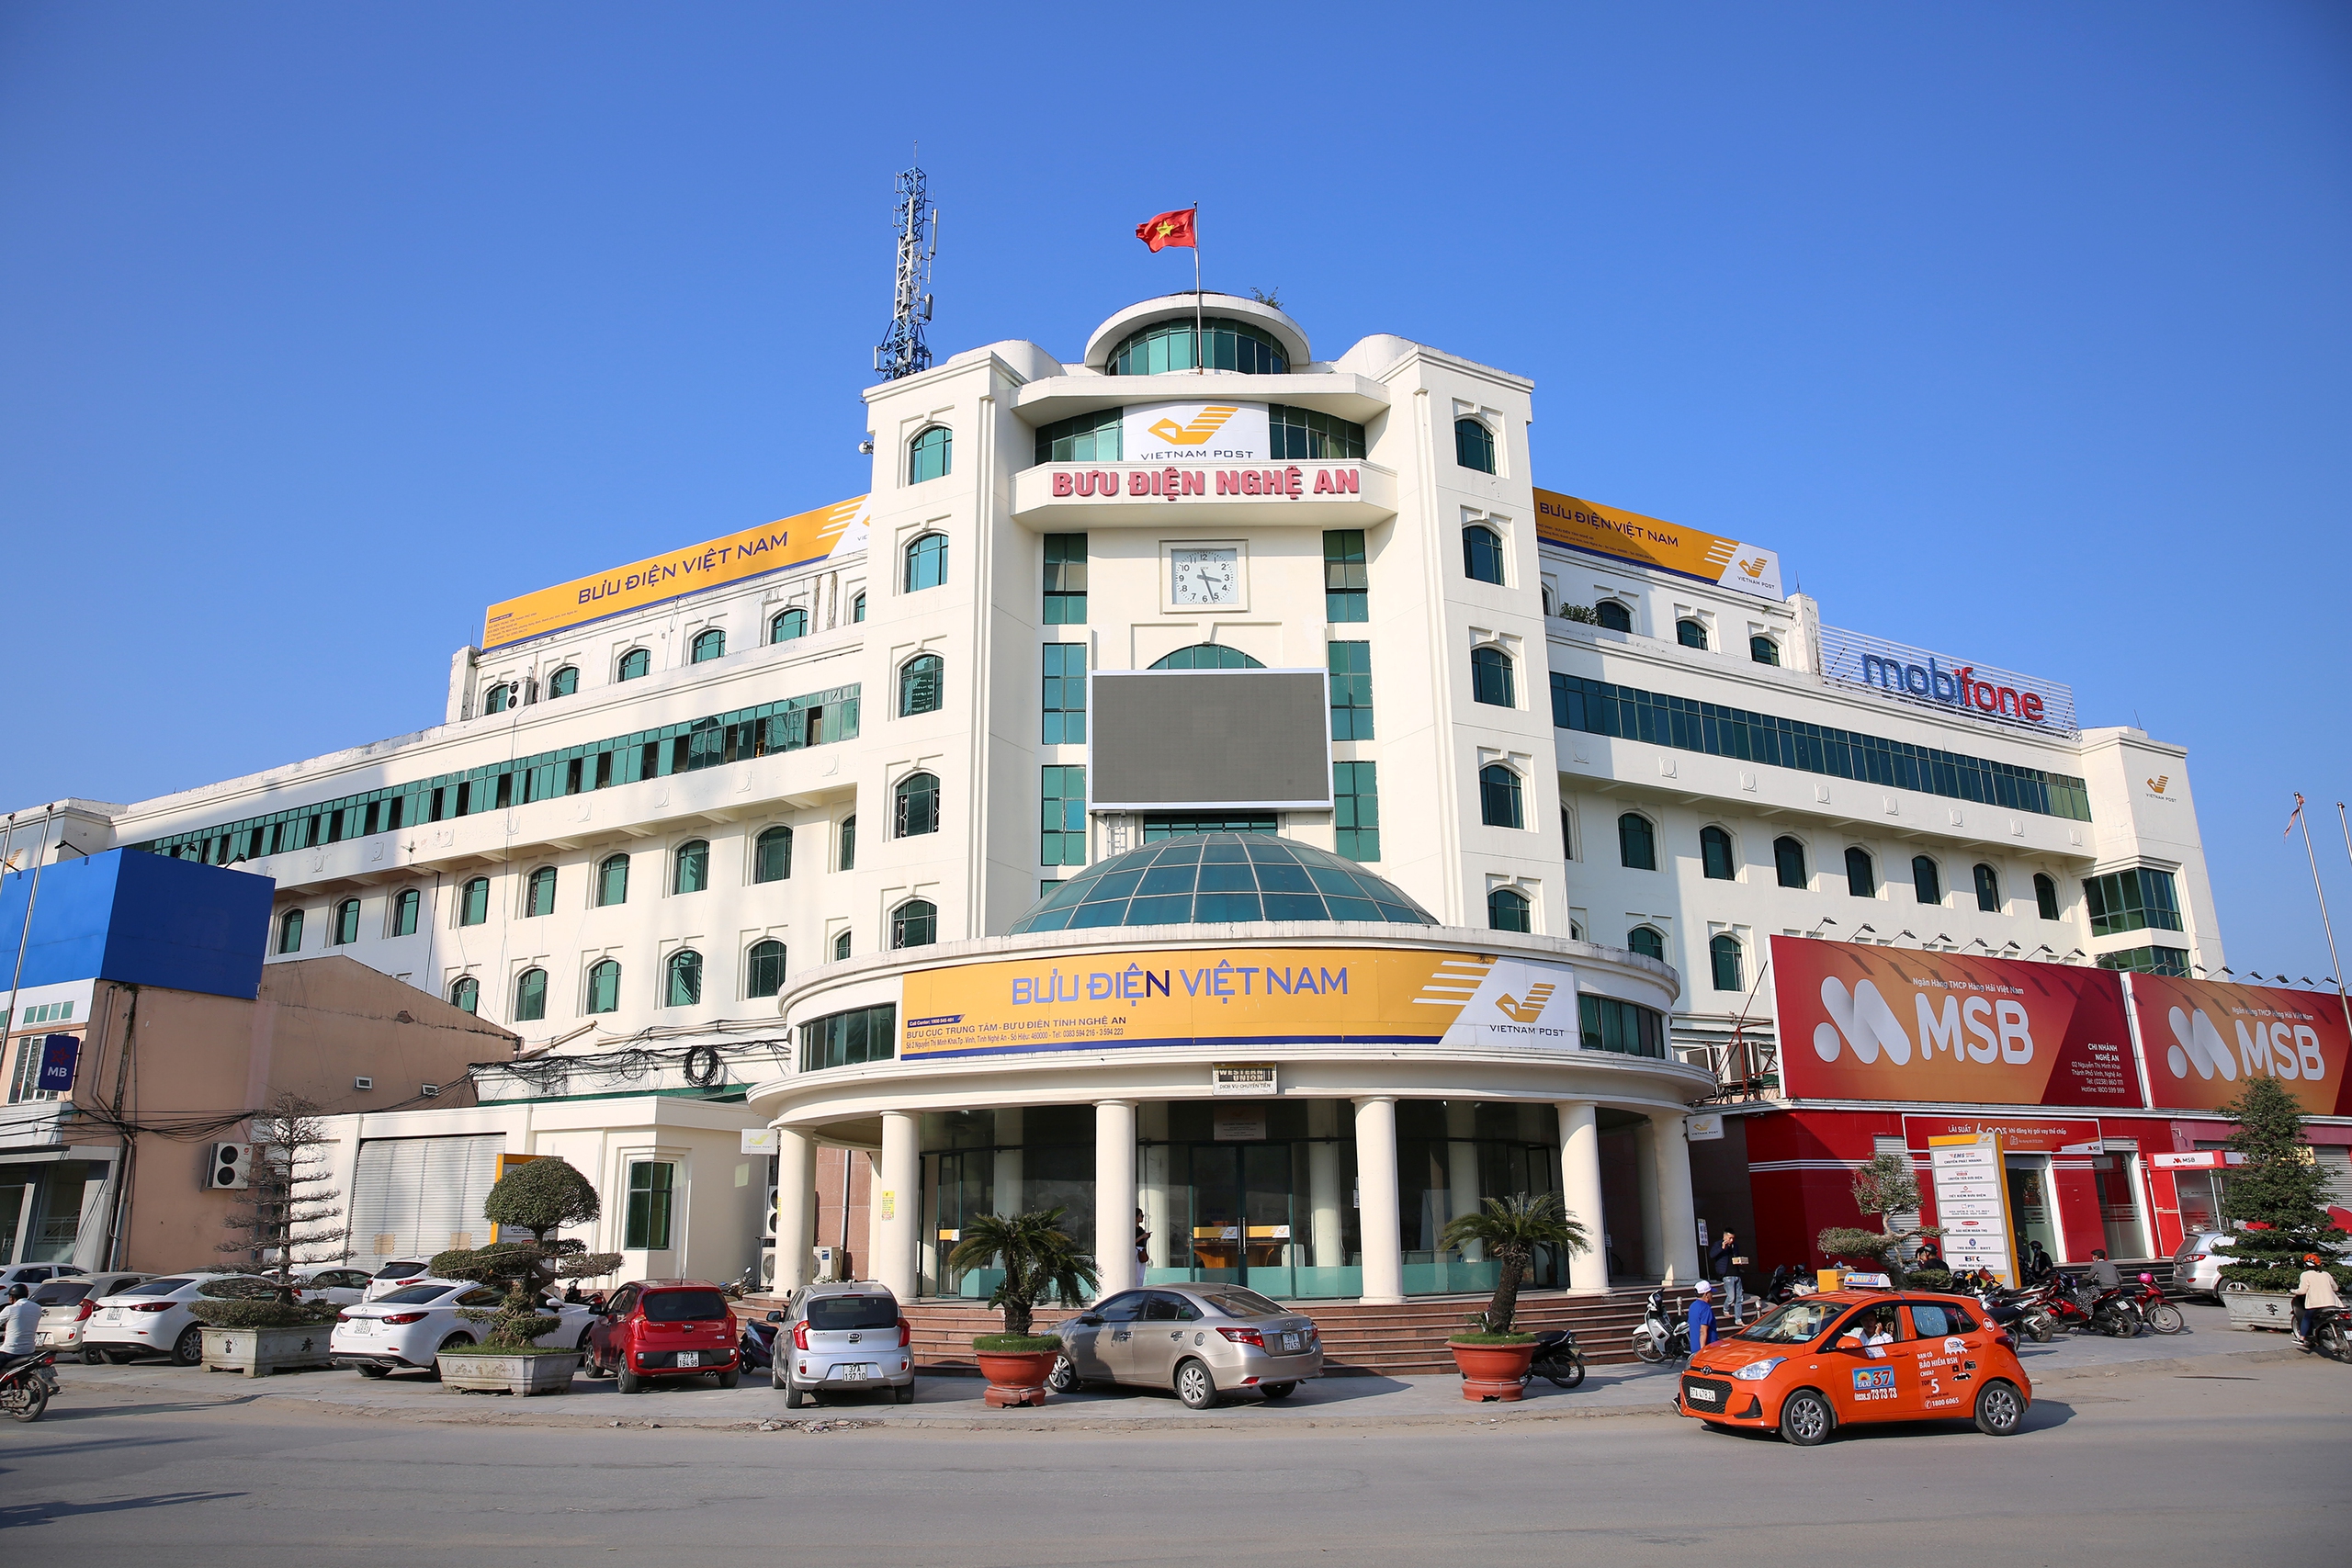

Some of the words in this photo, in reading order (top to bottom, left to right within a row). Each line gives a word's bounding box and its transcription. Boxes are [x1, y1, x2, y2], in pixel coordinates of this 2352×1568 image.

[1140, 450, 1207, 461] VIETNAM
[1214, 450, 1254, 458] POST
[1053, 469, 1120, 497] BƯU
[1127, 467, 1206, 502] ĐIỆN
[1216, 465, 1304, 500] NGHỆ
[1313, 468, 1361, 494] AN
[1539, 502, 1572, 520] BƯU
[1574, 511, 1611, 531] ĐIỆN
[1612, 521, 1645, 539] VIỆT
[1647, 530, 1679, 547] NAM
[1200, 553, 1208, 561] 12
[577, 578, 621, 604] BƯU
[625, 564, 676, 591] ĐIỆN
[683, 547, 732, 572] VIỆT
[737, 531, 788, 559] NAM
[1179, 574, 1184, 582] 9
[1737, 575, 1760, 586] VIETNAM
[1182, 584, 1188, 592] 8
[1202, 594, 1208, 603] 6
[1861, 653, 2045, 722] mobifone
[1012, 968, 1079, 1006] BƯU
[1086, 962, 1170, 1008] ĐIỆN
[1179, 958, 1261, 1005] VIỆT
[1266, 966, 1349, 995] NAM
[1912, 977, 1930, 987] Ngân
[1931, 979, 1949, 989] Hàng
[1949, 980, 1967, 989] TMCP
[1968, 982, 1985, 992] Hàng
[1985, 983, 1996, 992] Hải
[1996, 985, 2009, 995] Việt
[2010, 986, 2024, 995] Nam
[906, 1031, 924, 1039] BƯU
[945, 1025, 976, 1035] TRUNG
[978, 1022, 998, 1032] TÂM
[1003, 1021, 1025, 1030] BƯU
[1026, 1019, 1050, 1031] ĐIỆN
[1079, 1015, 1108, 1027] NGHỆ
[1489, 1023, 1536, 1035] VIETNAM
[1539, 1027, 1566, 1037] POST
[1915, 992, 2034, 1066] MSB
[2087, 1043, 2098, 1051] CHI
[2234, 1019, 2325, 1080] MSB
[47, 1066, 68, 1077] MB
[1931, 1357, 1946, 1366] HIỂM
[1872, 1370, 1892, 1386] 37
[1930, 1378, 1939, 1393] 5
[1871, 1388, 1880, 1400] 73
[1880, 1388, 1888, 1399] 73
[1888, 1387, 1897, 1399] 73
[1931, 1399, 1945, 1407] 1800
